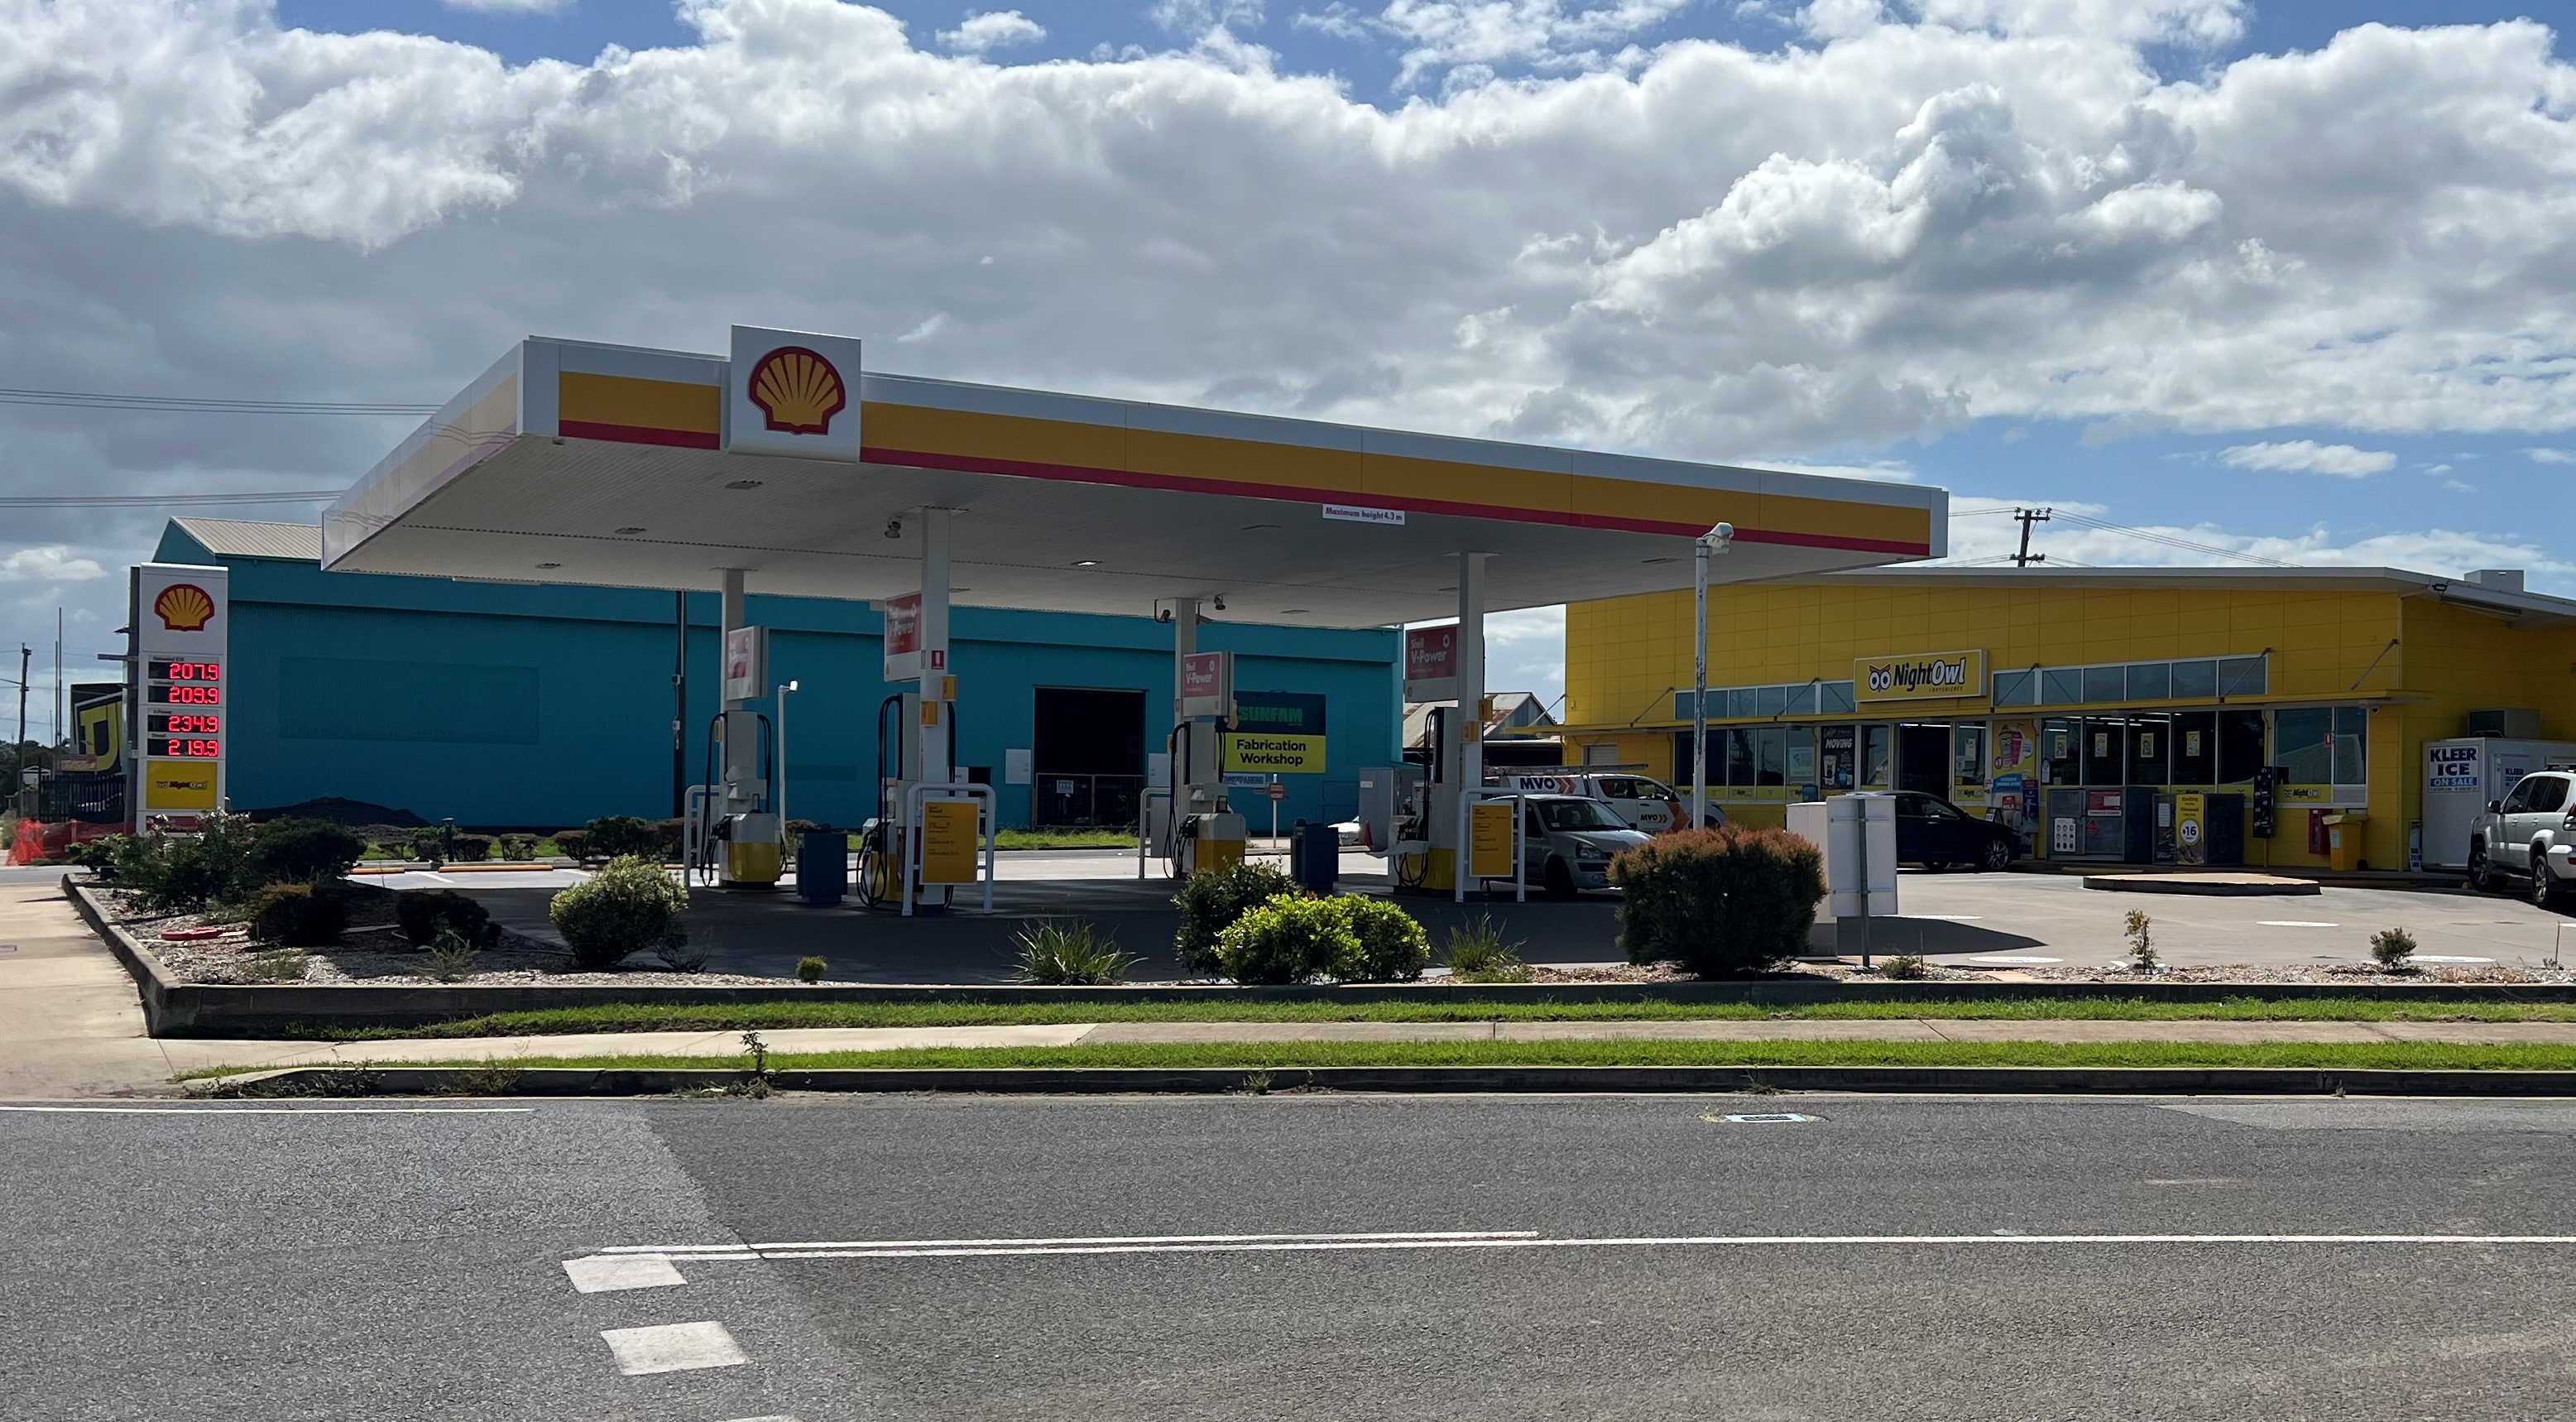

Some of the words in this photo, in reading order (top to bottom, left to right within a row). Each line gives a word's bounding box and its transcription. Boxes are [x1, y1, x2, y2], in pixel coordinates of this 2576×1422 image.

[1326, 507, 1360, 516] Maximum
[1361, 510, 1383, 520] height
[1411, 637, 1424, 649] Shell
[1411, 649, 1447, 664] V-Power
[170, 663, 218, 680] 207.9
[1893, 656, 1967, 692] NightOwl
[1186, 672, 1213, 685] V-Power
[169, 686, 218, 704] 209.9
[1239, 706, 1302, 723] SUNFAM
[169, 715, 218, 733] 234.9
[168, 738, 218, 757] 219.9
[1236, 739, 1306, 751] Fabrication
[1825, 738, 1853, 749] MOVING
[1240, 753, 1303, 766] Workshop
[2430, 748, 2477, 761] KLEER
[2438, 763, 2470, 776] ICE
[1519, 778, 1555, 790] MVO
[2183, 826, 2197, 836] $16
